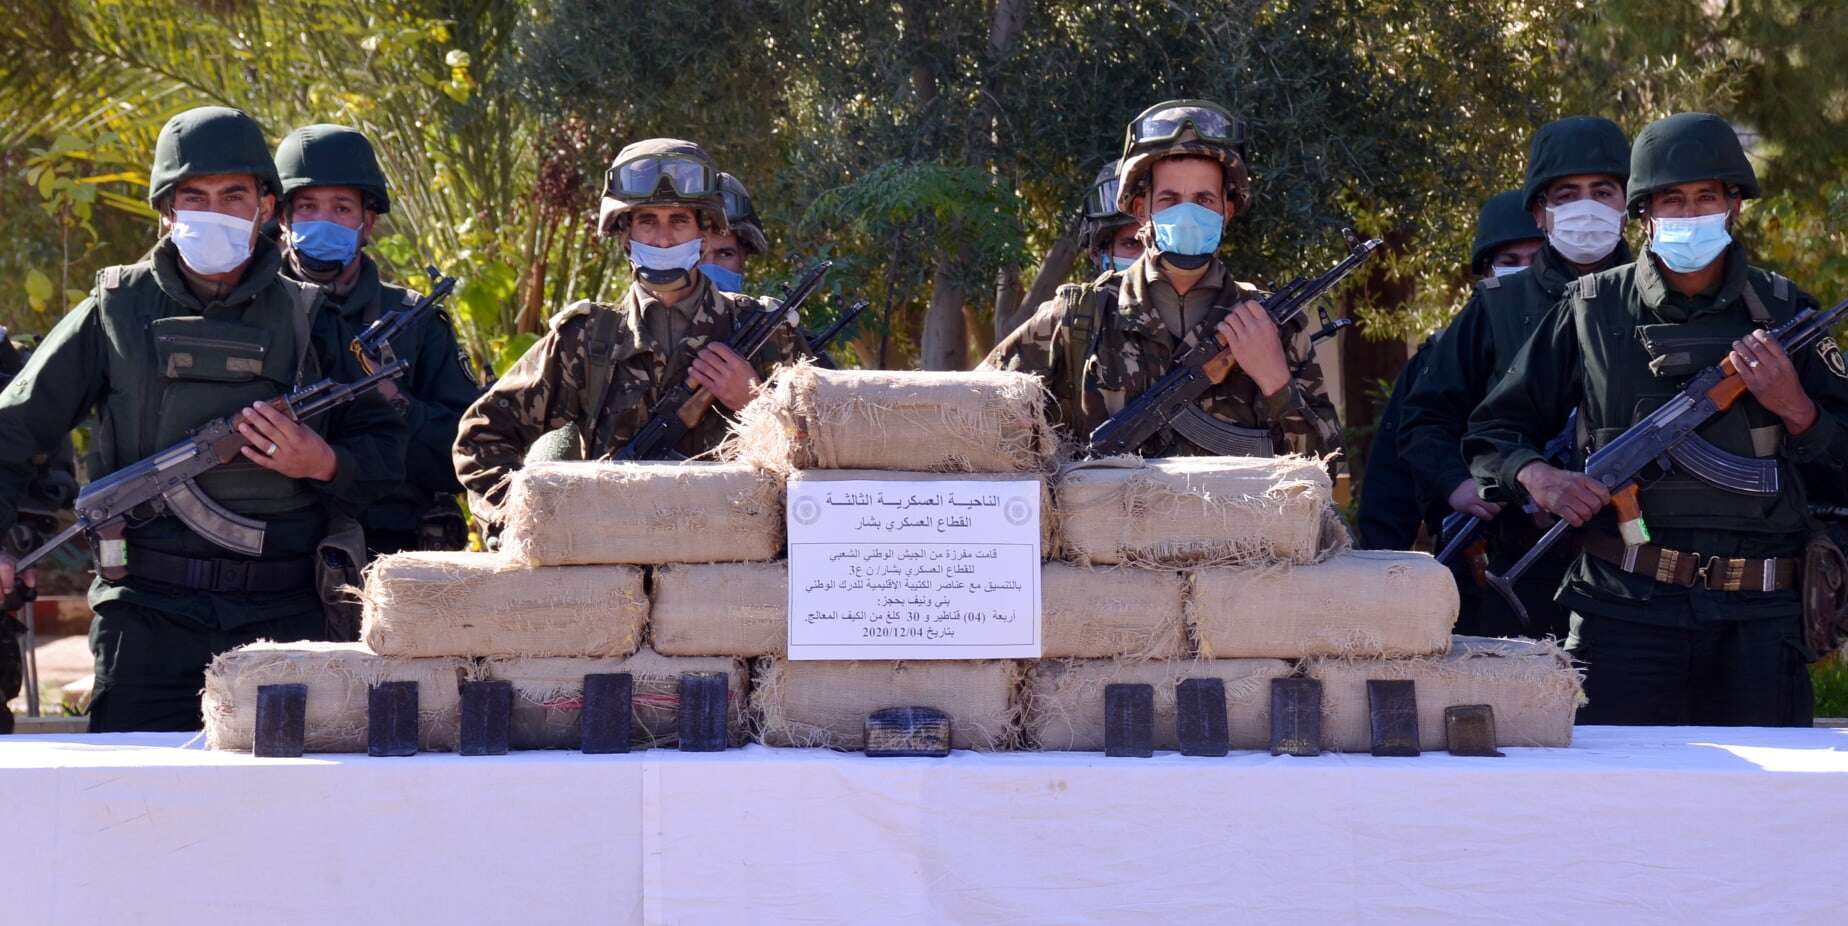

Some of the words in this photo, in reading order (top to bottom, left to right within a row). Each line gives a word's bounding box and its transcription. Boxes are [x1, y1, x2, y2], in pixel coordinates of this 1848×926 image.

[854, 518, 881, 530] بشار
[885, 516, 932, 531] العسكري
[937, 516, 971, 533] القطاع
[829, 548, 860, 561] الشعبي
[863, 548, 894, 561] الوطني
[897, 549, 927, 560] الجيش
[928, 551, 944, 560] من
[946, 549, 972, 561] مفرزة
[975, 549, 997, 560] قامت
[904, 564, 943, 577] العسكري
[946, 564, 975, 578] للقطاع
[805, 579, 836, 593] الوطني
[839, 580, 863, 592] للدرك
[904, 579, 932, 593] الكتيبة
[936, 580, 965, 592] عناصر
[968, 583, 981, 594] مع
[934, 596, 950, 609] بني
[840, 610, 866, 622] الكيف
[869, 612, 884, 622] من
[884, 610, 900, 624] كلغ
[906, 611, 920, 622] 30
[932, 609, 961, 624] قناطير
[964, 611, 986, 624] (04)
[862, 626, 924, 639] 2020/12/04
[925, 627, 955, 640] بتاريخ
